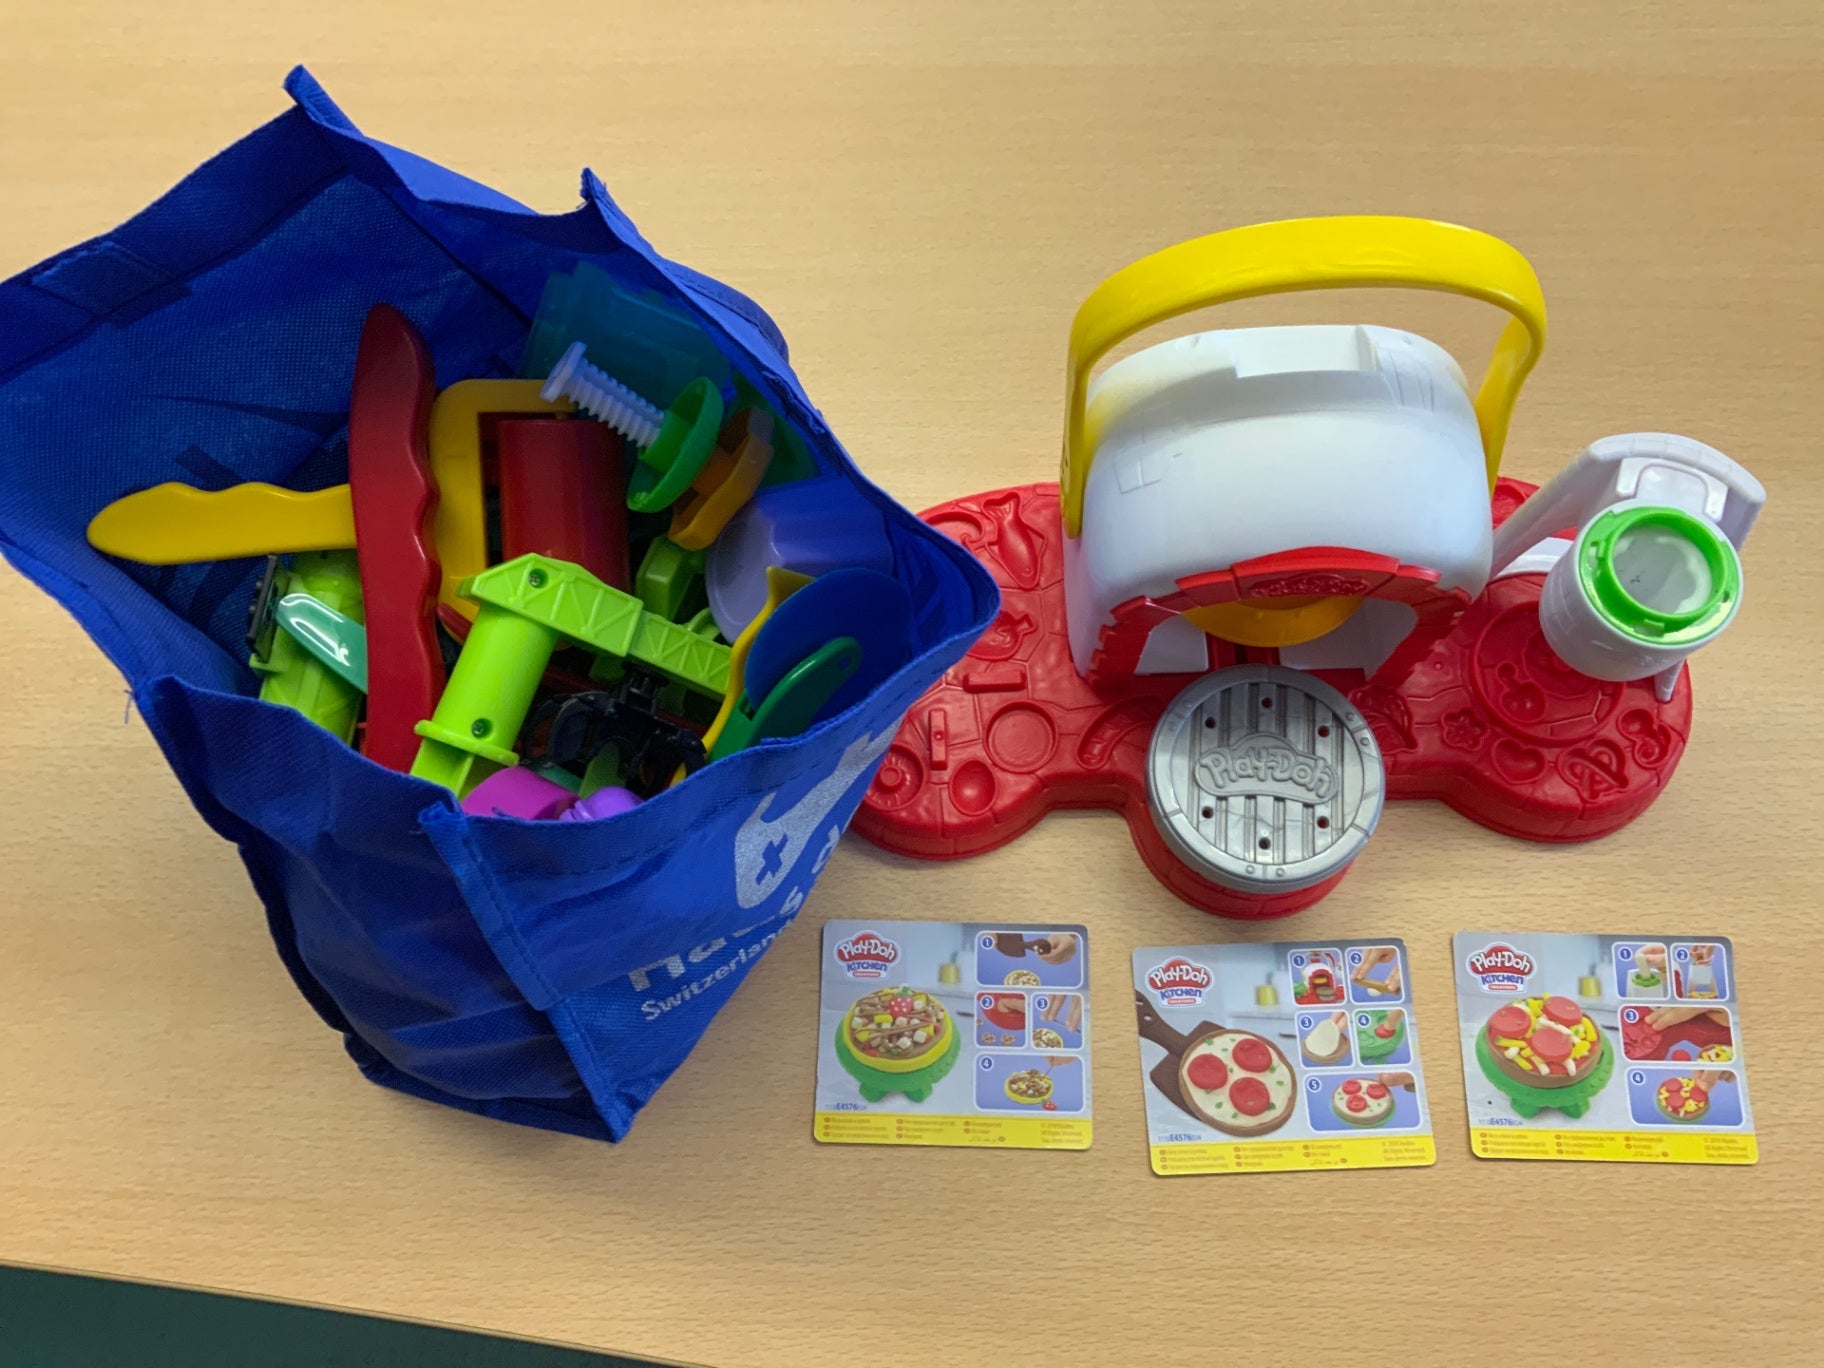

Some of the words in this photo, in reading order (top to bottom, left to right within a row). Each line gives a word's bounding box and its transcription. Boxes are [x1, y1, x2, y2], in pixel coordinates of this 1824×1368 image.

[1200, 746, 1332, 799] Play-Doh
[839, 939, 895, 960] Play-Doh
[1471, 951, 1530, 972] Play-Doh
[1150, 964, 1208, 987] Play-Doh
